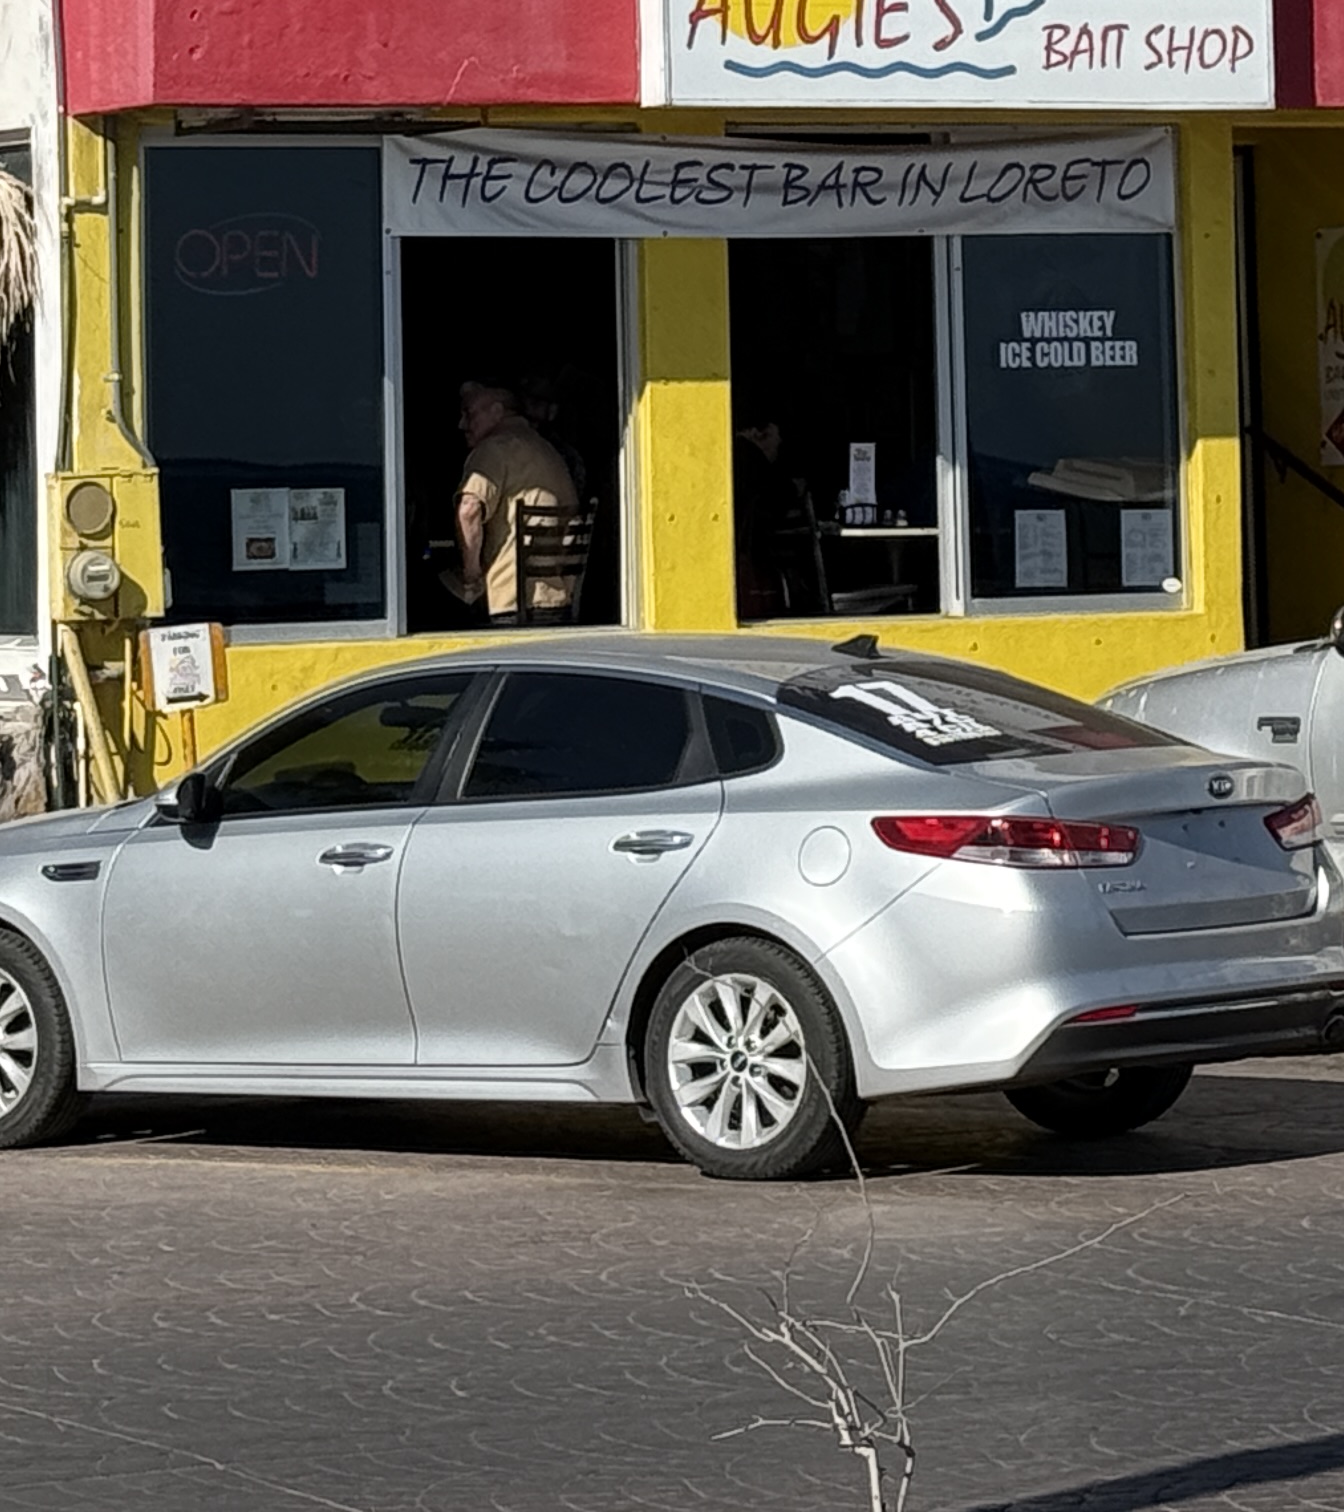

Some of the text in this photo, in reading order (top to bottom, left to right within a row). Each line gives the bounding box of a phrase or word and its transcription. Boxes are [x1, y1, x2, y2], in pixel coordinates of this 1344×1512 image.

[1041, 23, 1254, 74] BAIT SHOP
[409, 155, 1151, 208] THE COOLEST BAR IN LORETO
[175, 228, 318, 278] OPEN
[1020, 310, 1116, 338] WHISKEY
[1000, 340, 1138, 368] ICE COLD BEER
